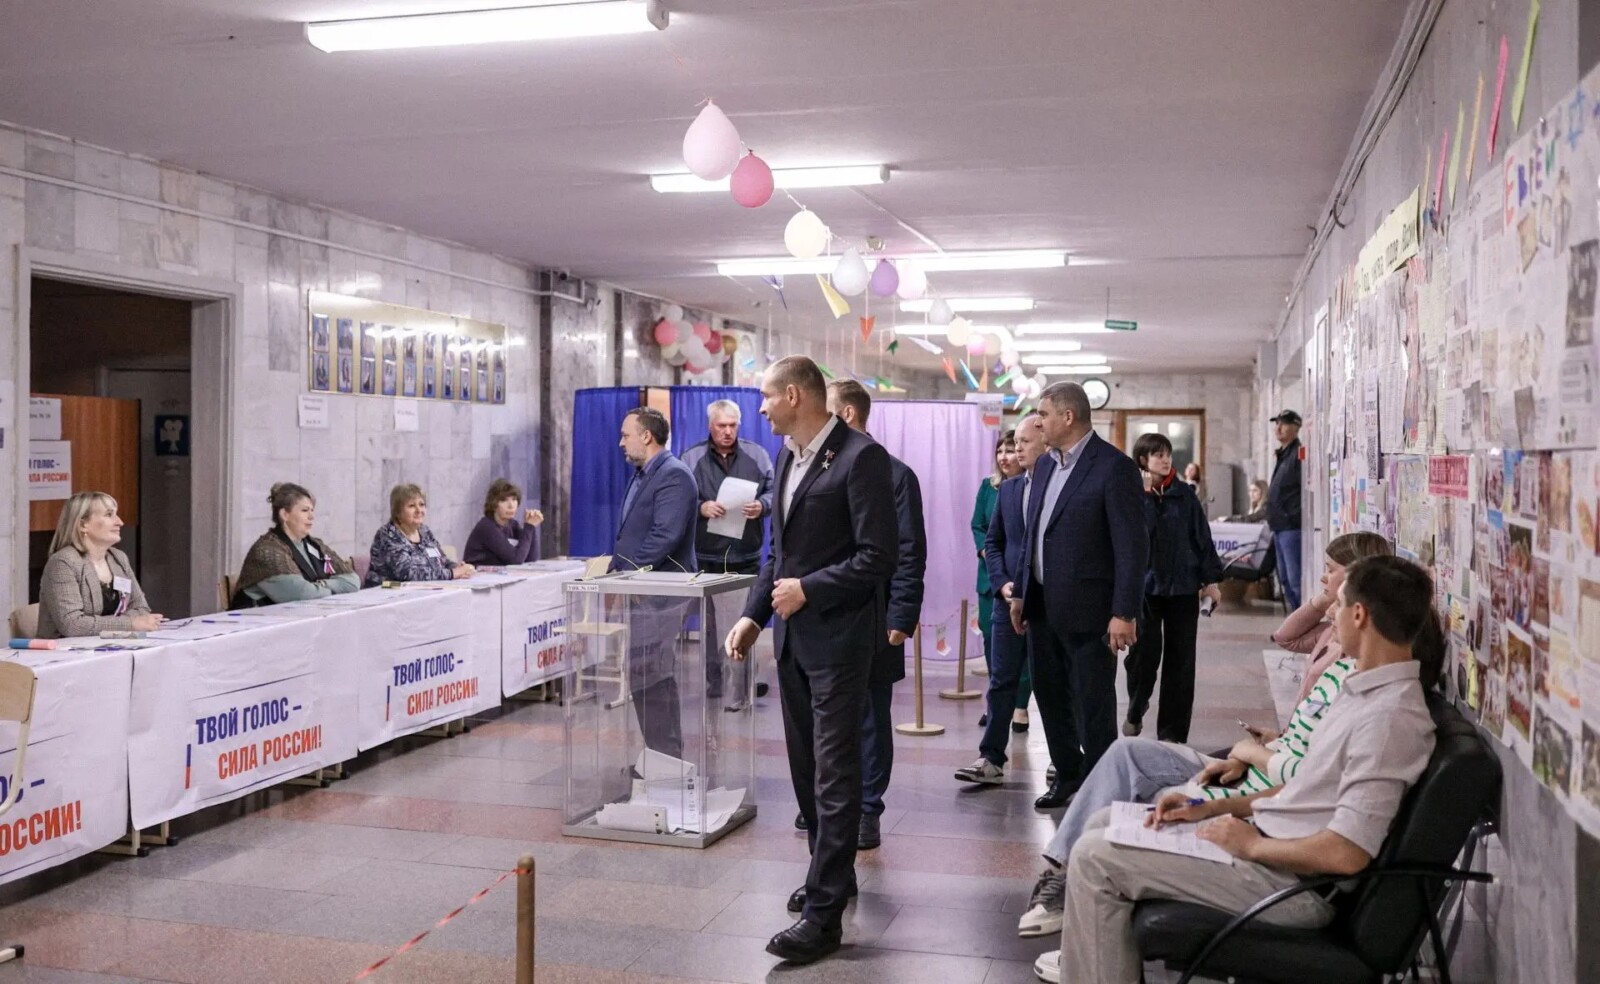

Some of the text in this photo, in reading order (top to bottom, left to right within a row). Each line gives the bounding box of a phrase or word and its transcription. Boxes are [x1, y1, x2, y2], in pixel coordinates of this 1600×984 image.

[527, 620, 548, 645] ТВОЙ
[393, 658, 422, 687] ТВОЙ
[424, 652, 455, 679] ГОЛОС
[537, 646, 558, 670] СИЛА
[407, 676, 478, 716] СИЛА РОССИИ!
[195, 707, 238, 745] ТВОЙ
[243, 696, 289, 733] ГОЛОС
[218, 724, 322, 780] СИЛА РОССИИ!
